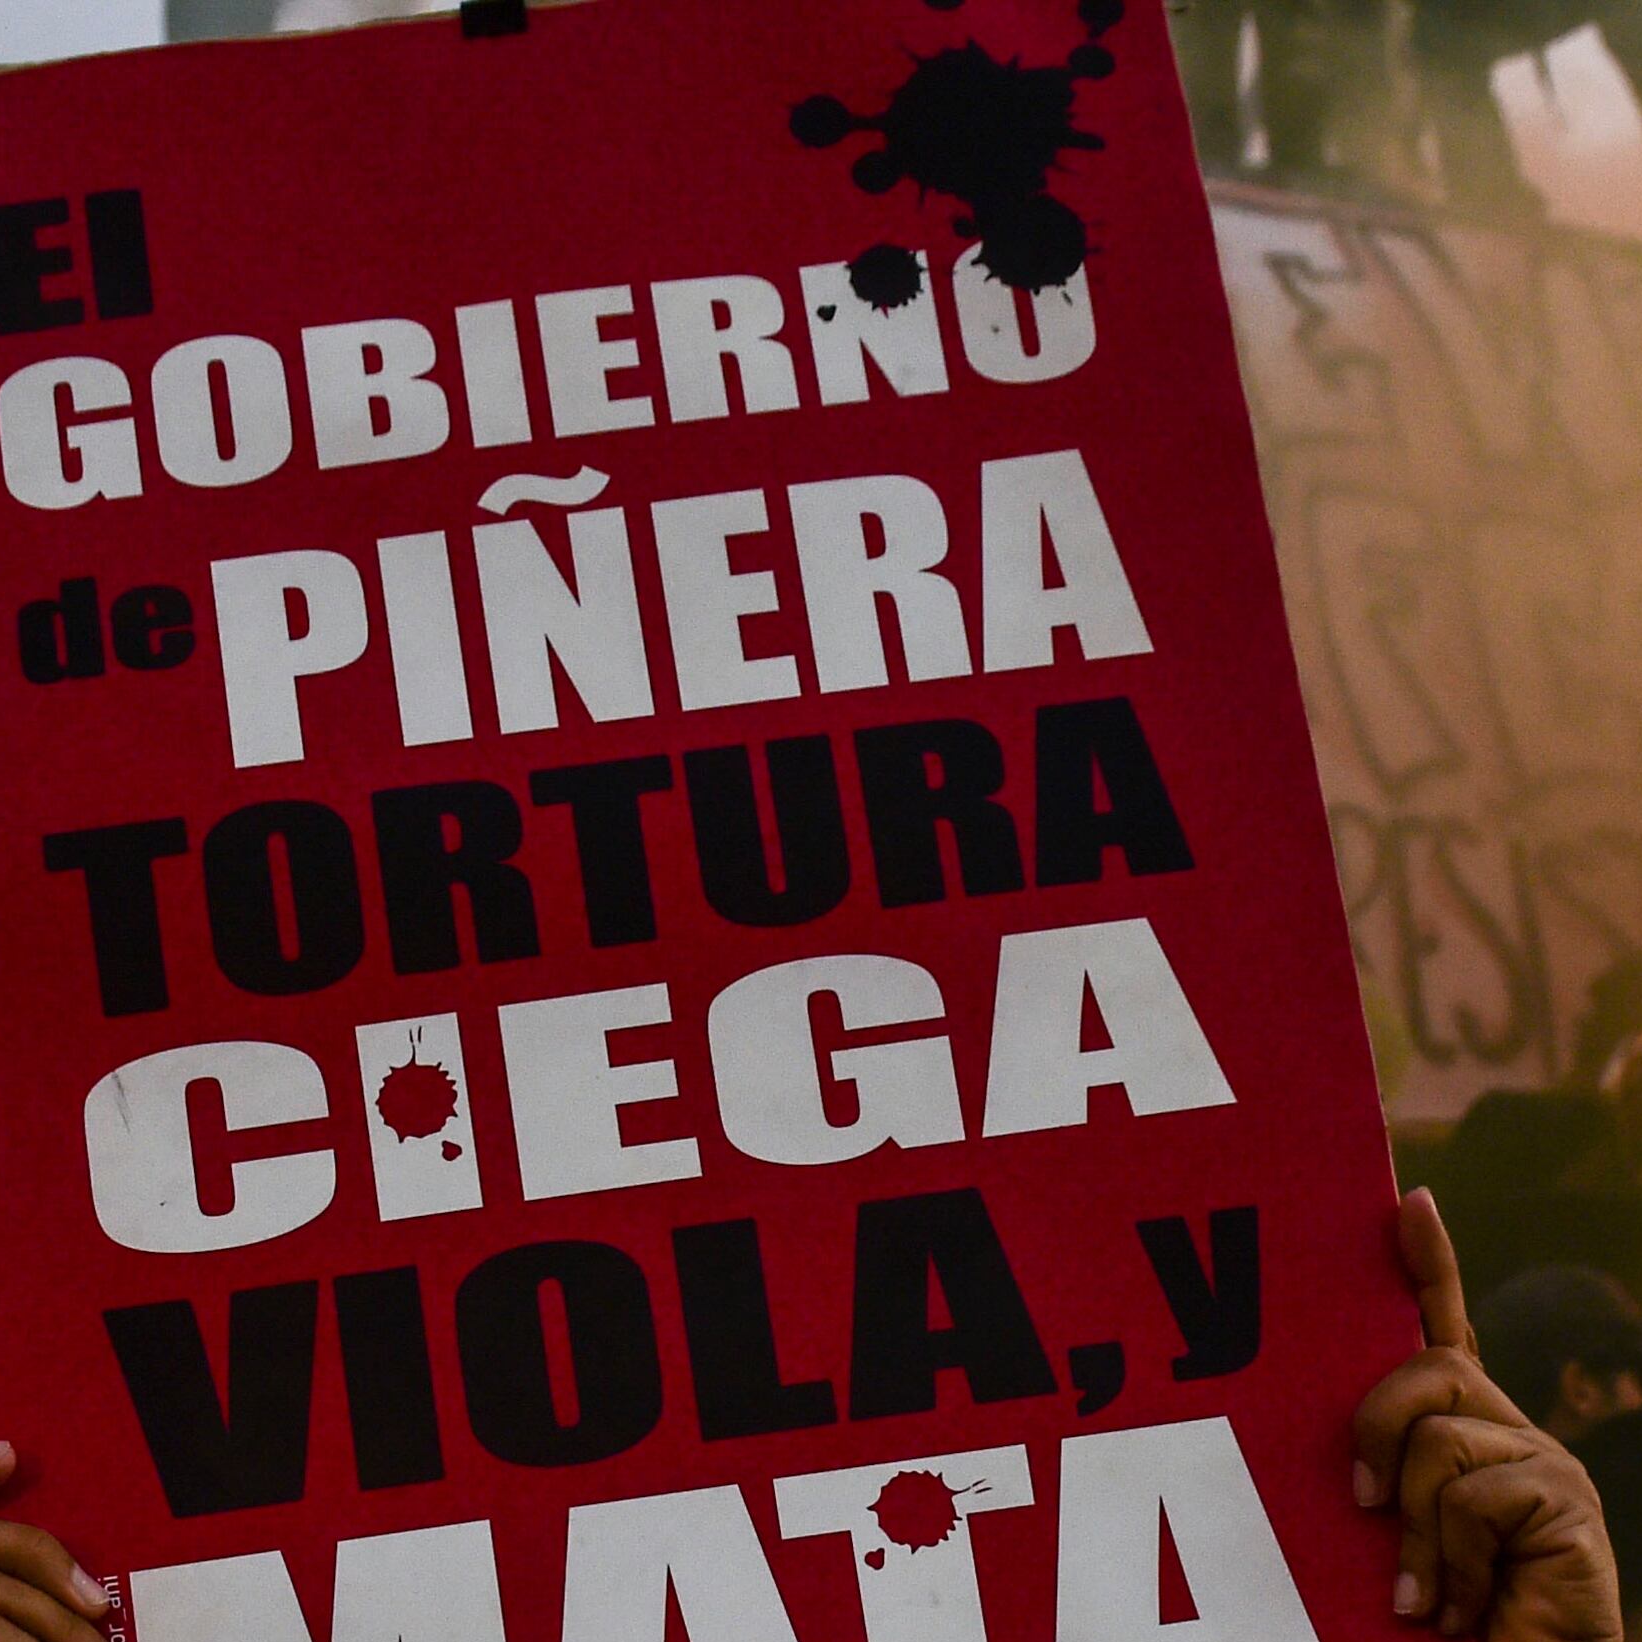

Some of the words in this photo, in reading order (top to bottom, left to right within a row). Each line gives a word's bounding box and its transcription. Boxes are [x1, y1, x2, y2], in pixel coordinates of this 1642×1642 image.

[17, 576, 196, 686] de
[209, 449, 1155, 769] PIÑERA
[42, 696, 1196, 1018] TORTURA
[84, 918, 1237, 1254] CIEGA
